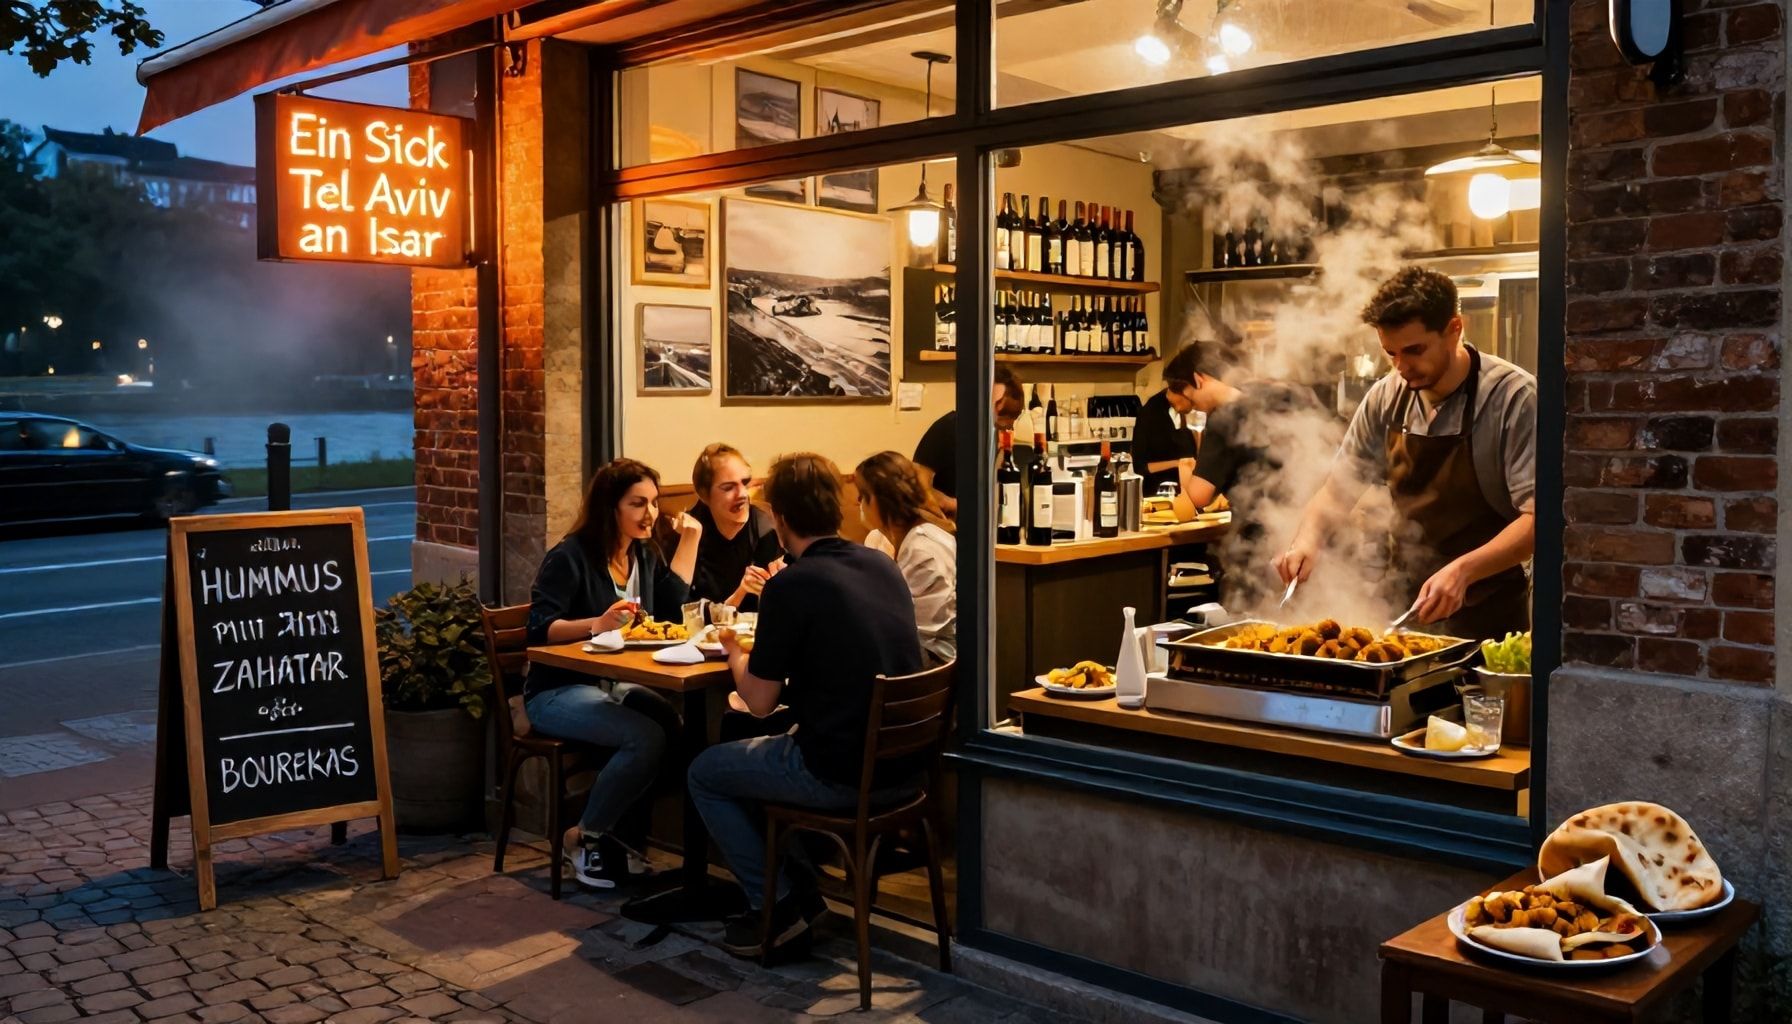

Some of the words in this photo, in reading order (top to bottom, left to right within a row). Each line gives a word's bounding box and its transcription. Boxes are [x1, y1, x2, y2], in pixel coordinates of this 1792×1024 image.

[290, 112, 351, 159] Ein
[365, 121, 449, 169] Sick
[289, 168, 354, 211] Tel
[364, 172, 451, 218] Aviv
[299, 223, 348, 254] an
[370, 217, 445, 257] Isar
[201, 560, 342, 604] HUMMUS
[213, 651, 348, 693] ZAHATAR
[221, 745, 359, 793] BOUREKAS
